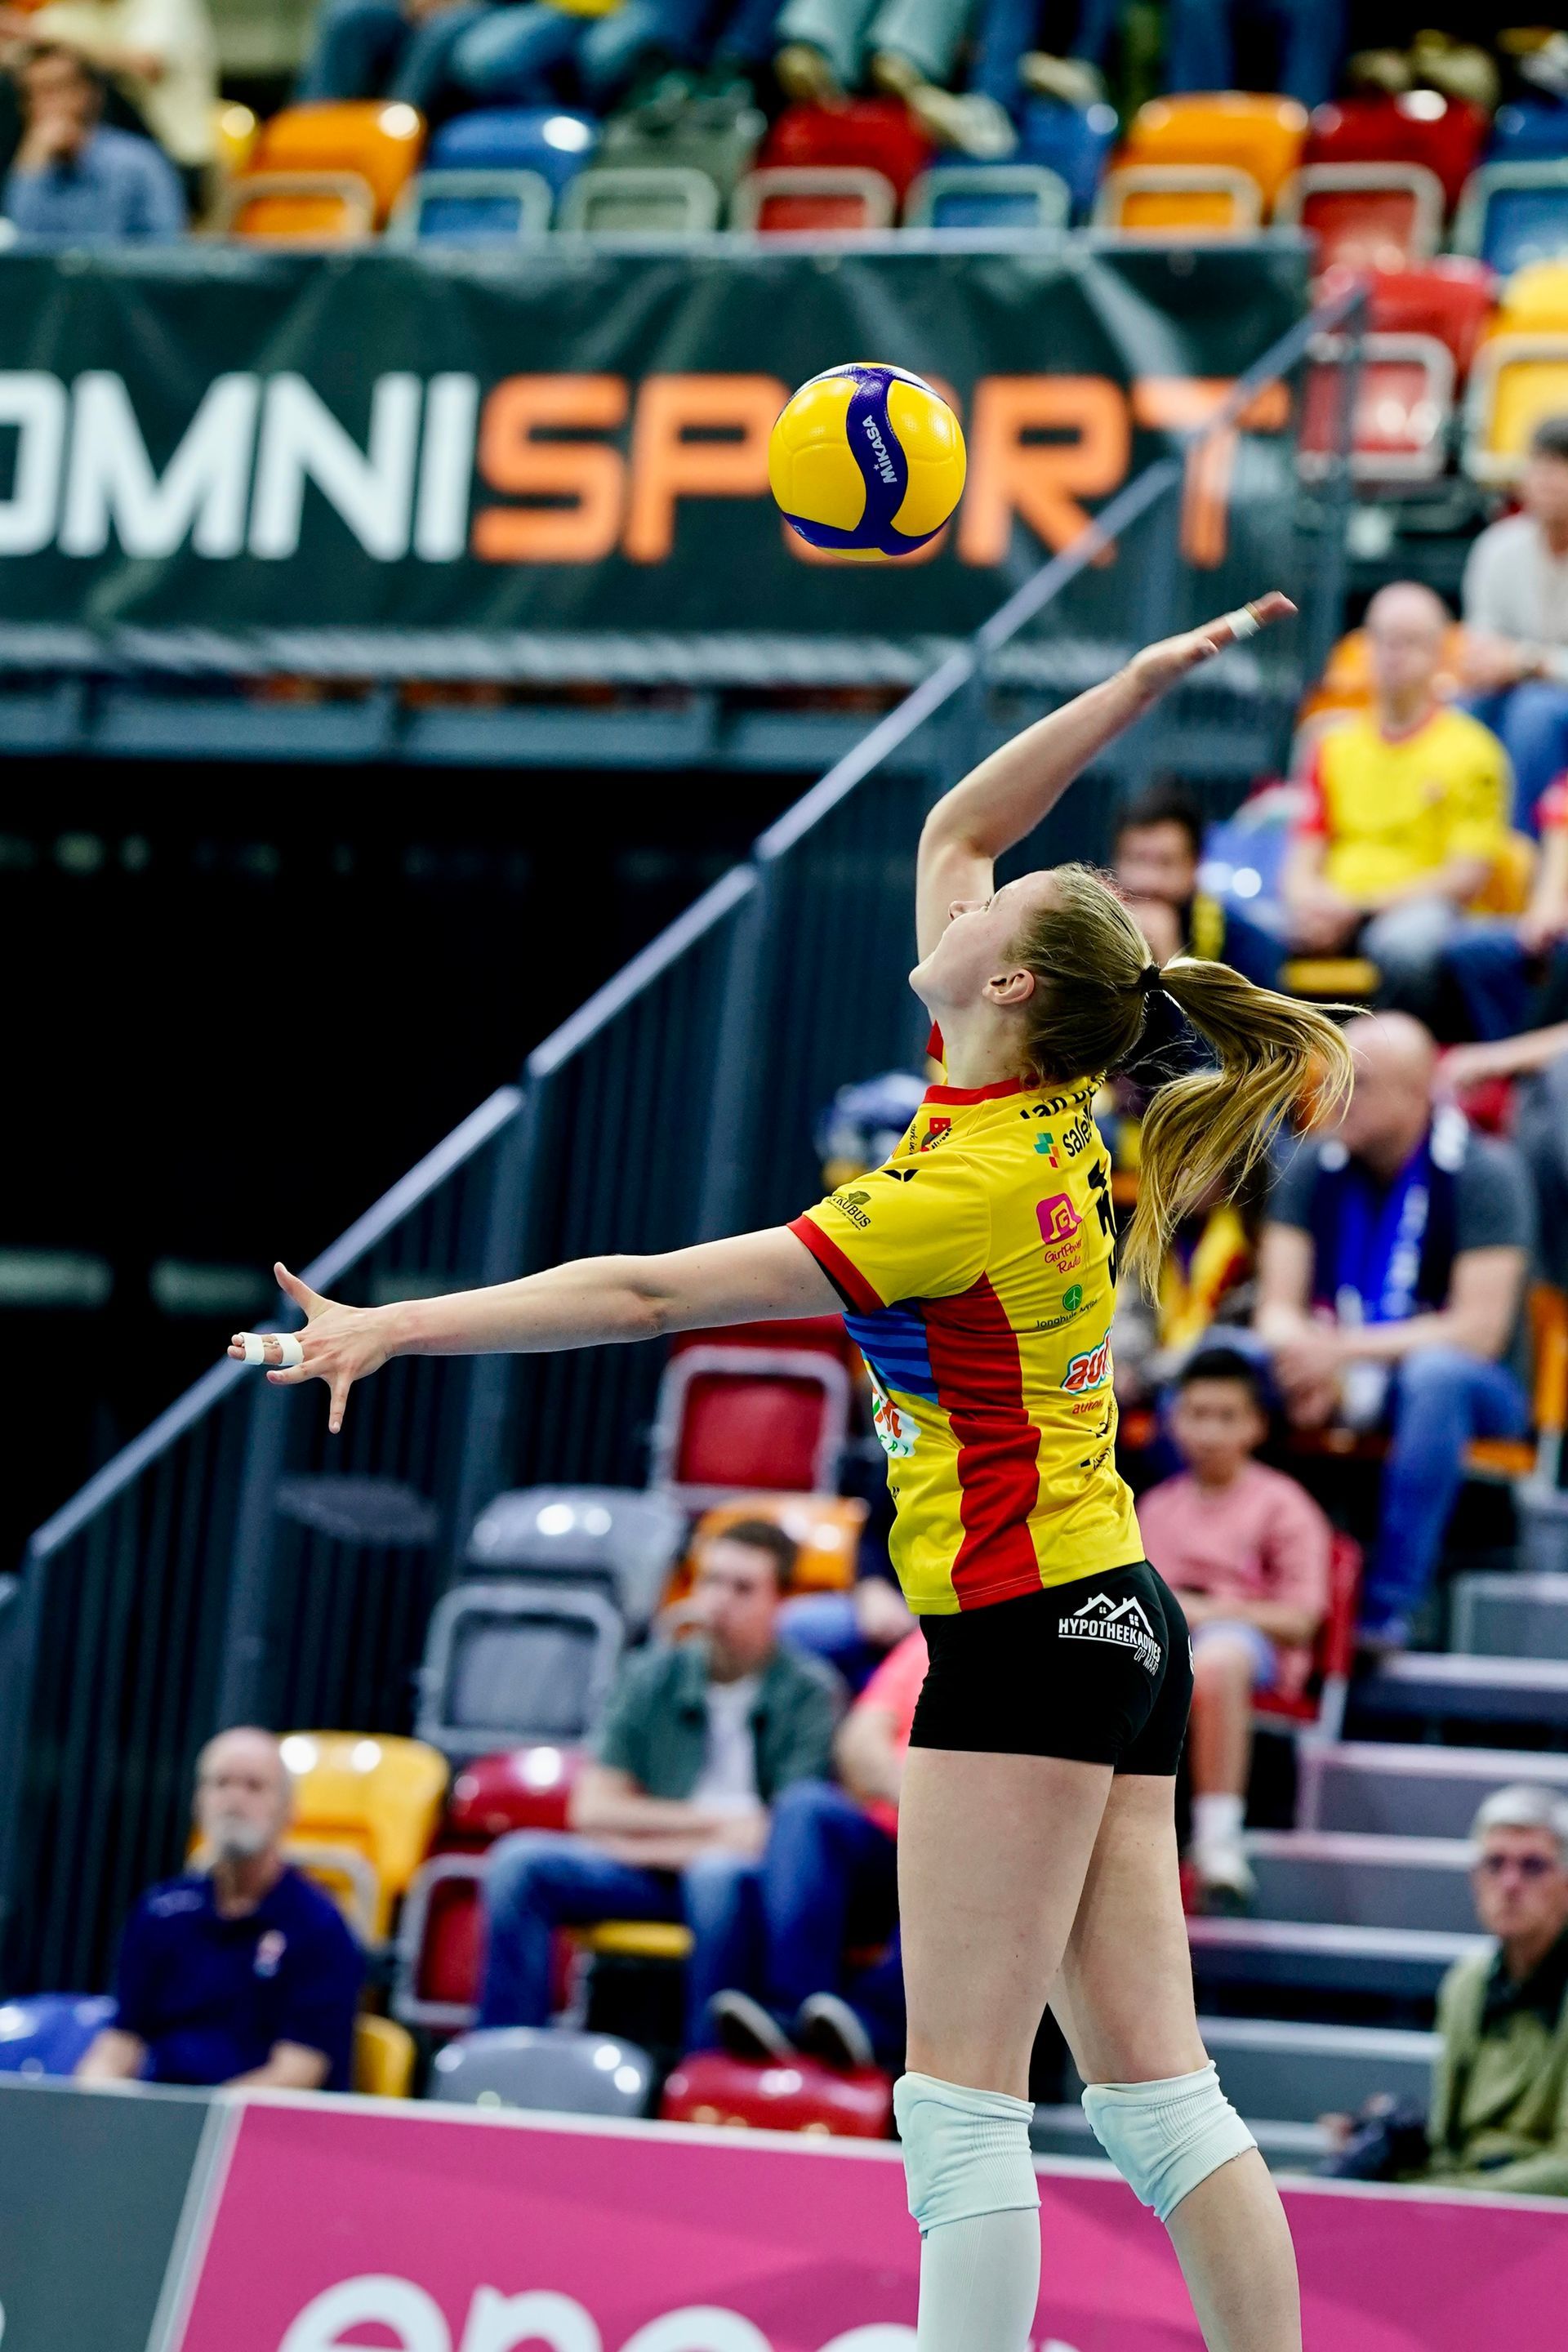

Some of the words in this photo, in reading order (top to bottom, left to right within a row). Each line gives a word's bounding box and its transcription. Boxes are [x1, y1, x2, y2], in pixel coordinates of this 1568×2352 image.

[0, 369, 1289, 569] MNISPRT
[862, 414, 898, 483] MIKASA
[1058, 1619, 1161, 1663] HYPOTHEEKADVIES
